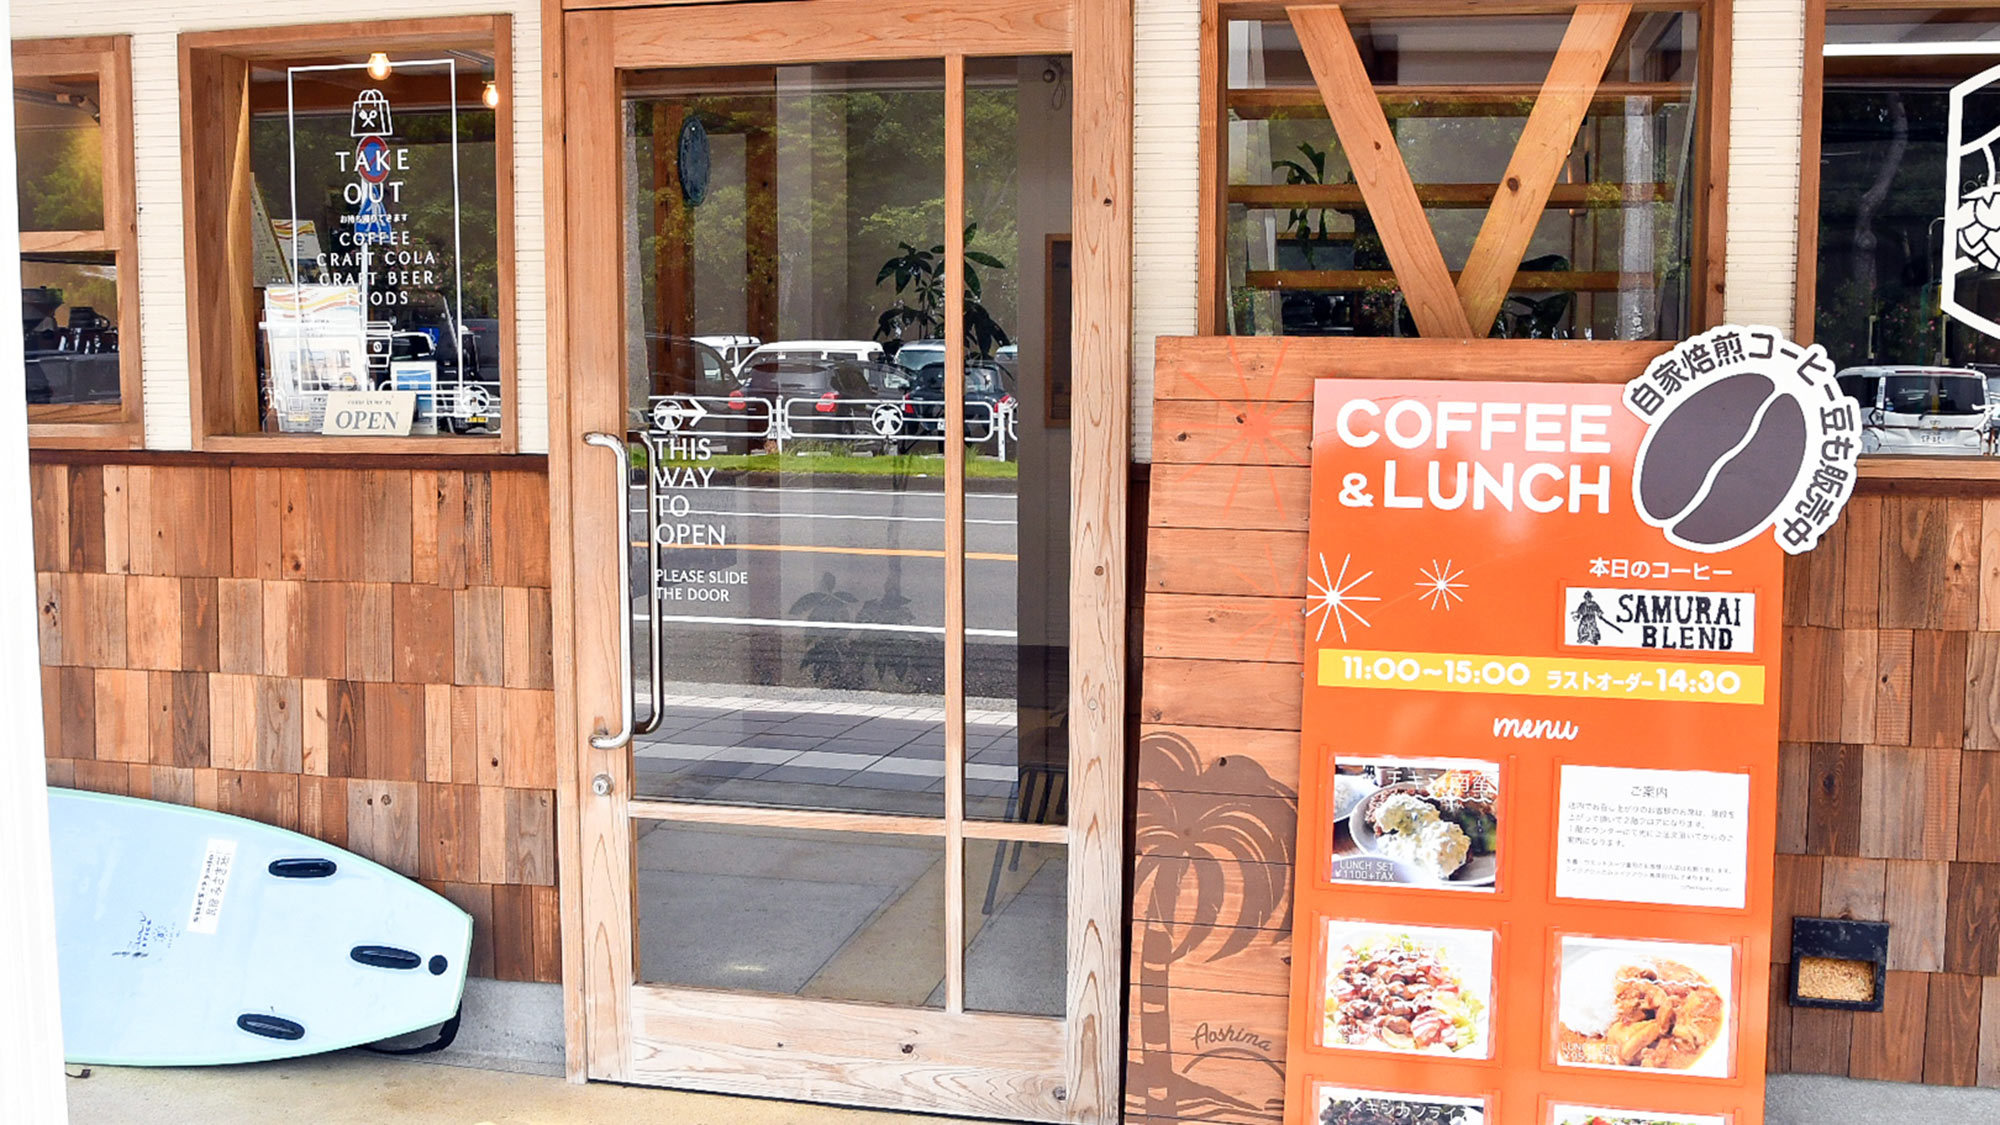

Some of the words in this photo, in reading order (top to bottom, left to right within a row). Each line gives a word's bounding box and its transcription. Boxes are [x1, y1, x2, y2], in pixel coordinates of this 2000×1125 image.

[335, 149, 410, 172] TAKE
[343, 181, 404, 204] OUT
[339, 231, 410, 246] COFFEE
[316, 252, 375, 267] CRAFT
[384, 250, 435, 265] COLA
[319, 272, 378, 287] CRAFT
[388, 270, 434, 285] BEER
[335, 410, 399, 430] OPEN
[1336, 398, 1612, 453] COFFEE
[653, 437, 711, 460] THIS
[1630, 331, 1854, 546] 自家焙煎コーヒー豆も販売中
[655, 467, 715, 488] WAY
[1338, 472, 1374, 507] &
[1384, 460, 1611, 513] LUNCH
[655, 495, 690, 517] TO
[655, 523, 726, 546] OPEN
[656, 569, 705, 583] PLEASE
[709, 570, 748, 584] SLIDE
[1589, 557, 1733, 580] 本日のコーヒー
[656, 587, 683, 600] THE
[688, 588, 730, 602] DOOR
[1616, 594, 1741, 626] SAMURAI
[1642, 625, 1733, 650] BLEND
[1493, 717, 1579, 741] menu
[1631, 785, 1668, 798] ご案内
[1340, 860, 1372, 870] LUNCH
[1376, 861, 1393, 871] SET
[1191, 1022, 1272, 1051] Aoshima
